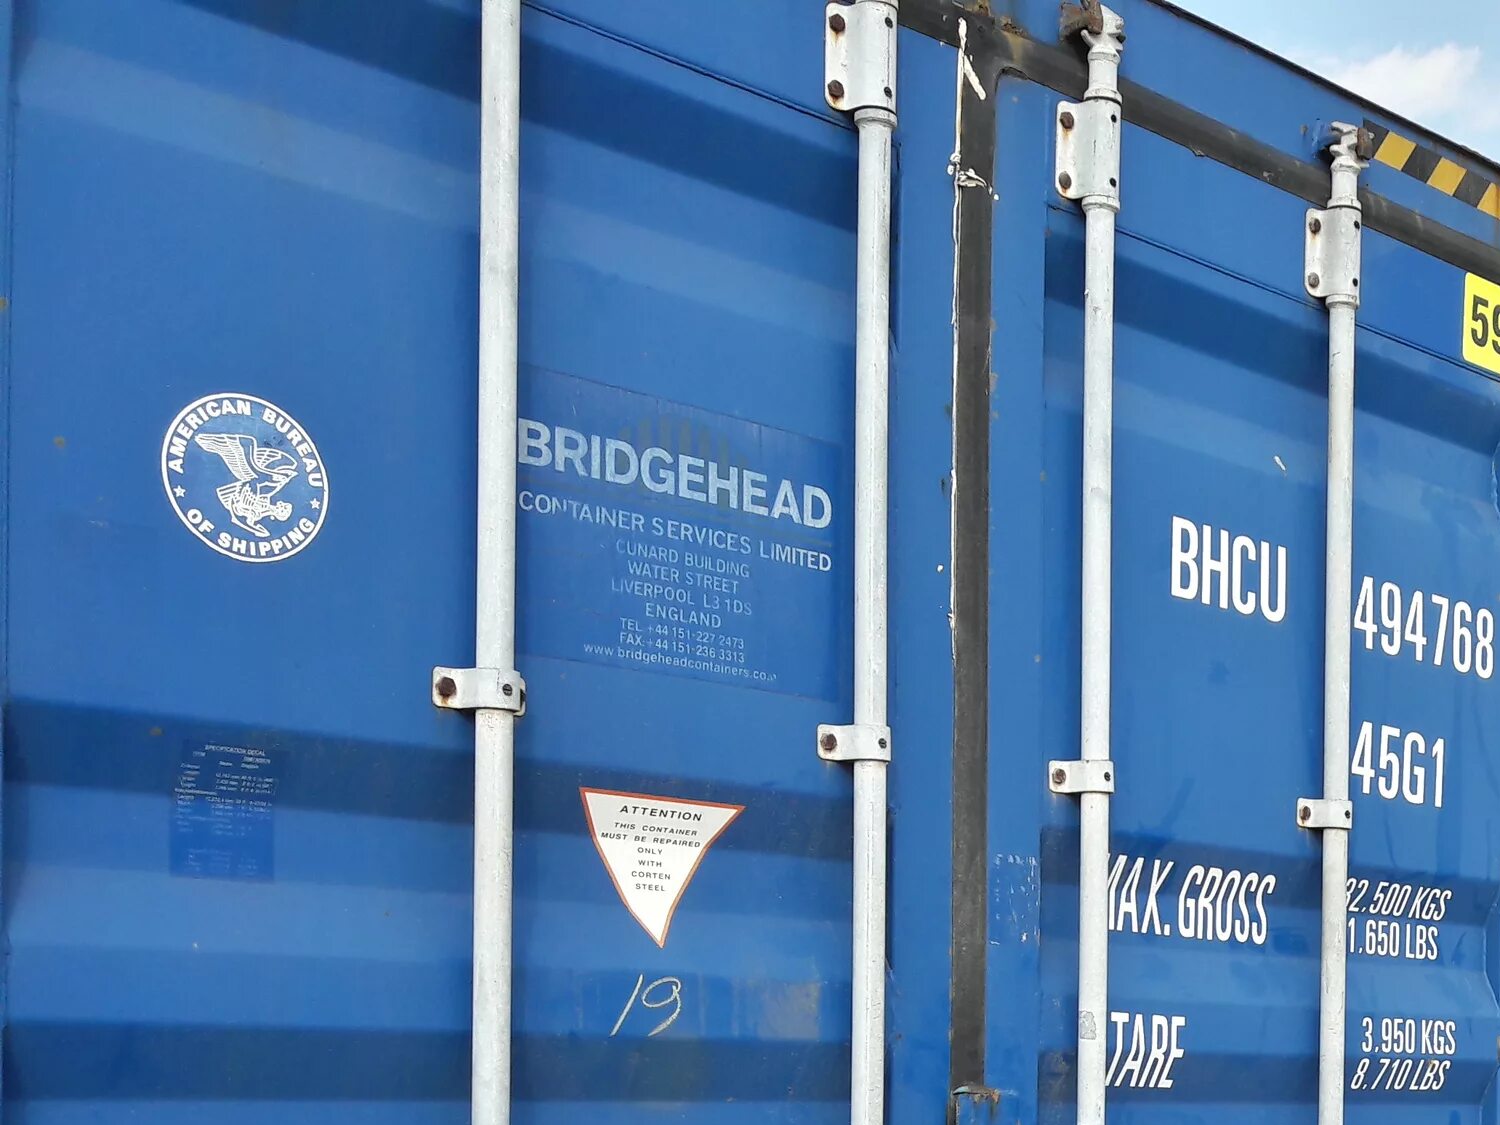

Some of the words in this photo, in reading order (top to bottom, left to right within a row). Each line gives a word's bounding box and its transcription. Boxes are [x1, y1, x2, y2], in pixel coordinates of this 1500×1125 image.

[168, 400, 252, 474] AMERICAN
[262, 408, 324, 487] BUREAU
[518, 417, 832, 529] BRIDGEHEAD
[187, 509, 215, 533] OF
[218, 517, 315, 556] SHIPPING
[519, 490, 644, 532] CONTAINER
[651, 517, 752, 555] SERVICES
[760, 541, 832, 572] LIMITED
[616, 539, 679, 563] CUNARD
[685, 552, 751, 578] BUILDING
[627, 560, 680, 583] WATER
[686, 573, 739, 594] STREET
[611, 578, 695, 605] LIVERPOOL
[703, 594, 720, 610] L3
[725, 599, 752, 616] 1DS
[1170, 515, 1287, 622] BHCU
[1354, 576, 1494, 680] 494768
[645, 603, 722, 629] ENGLAND
[648, 624, 668, 636] +44
[672, 626, 715, 643] 151-227
[719, 635, 744, 649] 2473
[672, 641, 715, 658] 151-236
[719, 649, 745, 663] 3313
[1351, 720, 1446, 809] 45G1
[614, 822, 636, 831] THIS
[642, 824, 698, 837] CONTAINER
[620, 804, 703, 822] ATTENTION
[601, 832, 628, 841] MUST
[634, 835, 647, 844] BE
[653, 837, 701, 848] REPAIRED
[637, 846, 663, 856] ONLY
[631, 870, 671, 881] CORTEN
[638, 859, 663, 868] WITH
[635, 883, 666, 892] STEEL
[1178, 865, 1276, 945] GROSS
[1408, 886, 1452, 921] KGS
[1348, 917, 1400, 957] 1,650
[1405, 923, 1438, 960] LBS
[610, 974, 682, 1037] 19
[1105, 1011, 1186, 1090] TARE
[1421, 1019, 1456, 1055] KGS
[1409, 1059, 1451, 1090] LBS
